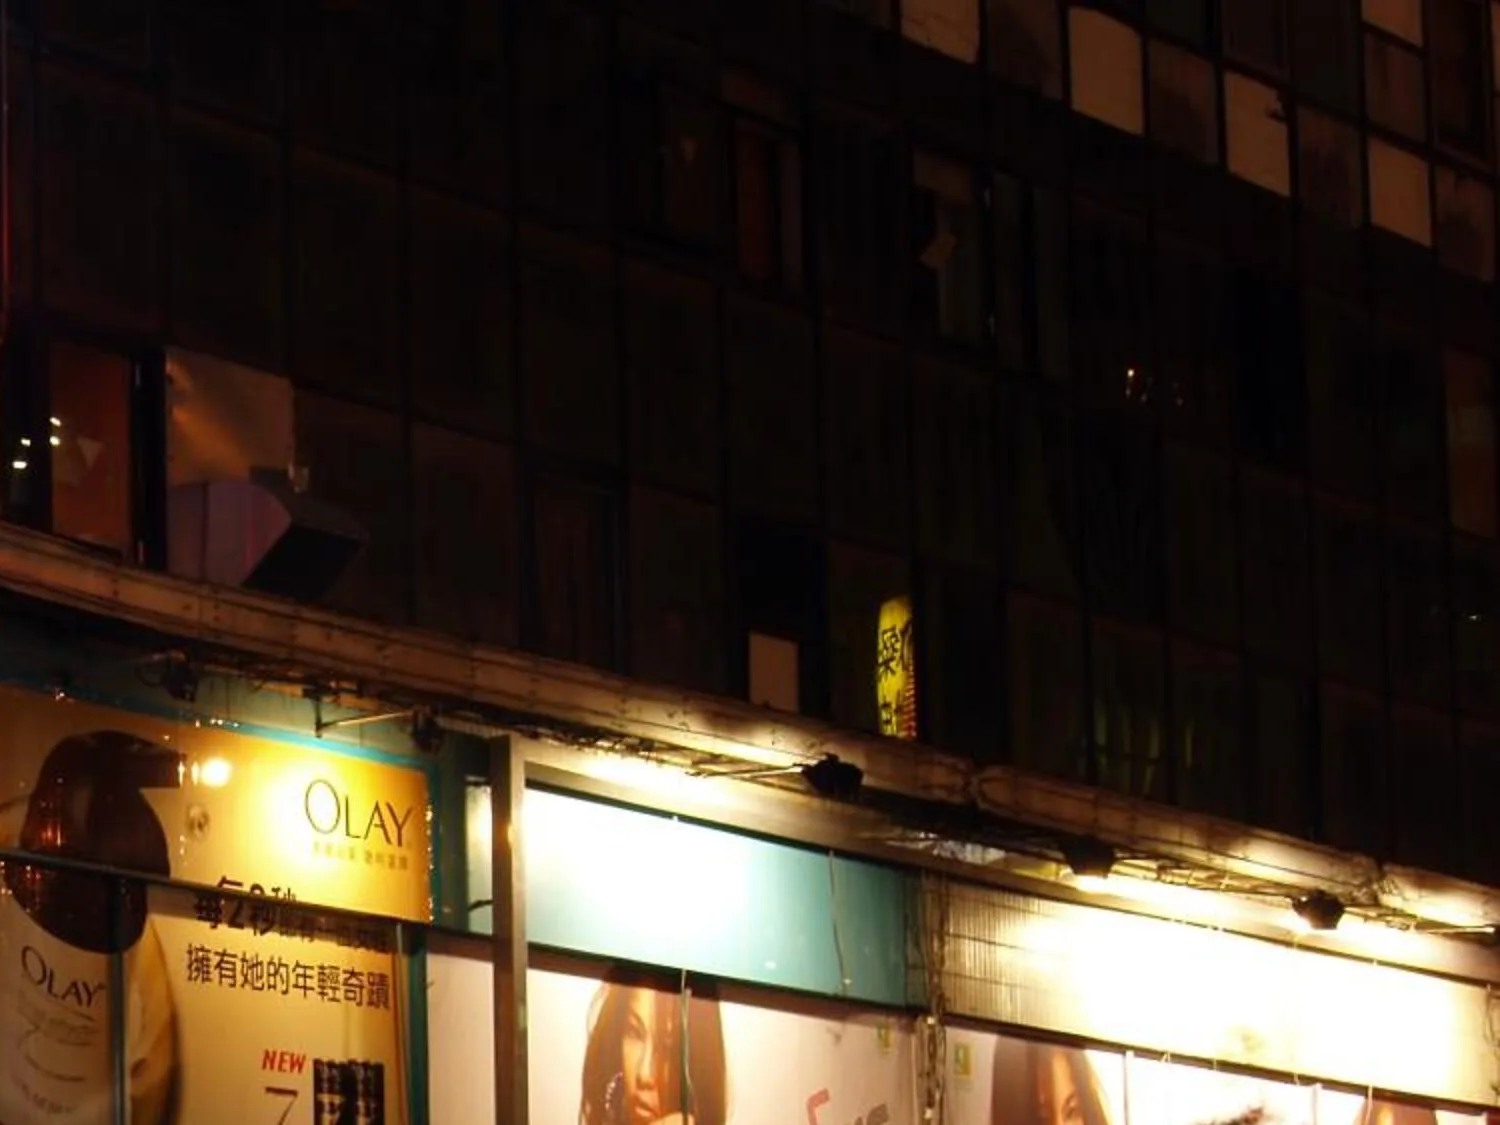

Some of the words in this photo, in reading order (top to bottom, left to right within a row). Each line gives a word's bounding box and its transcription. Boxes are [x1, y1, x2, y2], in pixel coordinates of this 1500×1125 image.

[305, 779, 414, 848] OLAY
[21, 945, 107, 1008] OLAY
[187, 943, 390, 1009] 擁有她的年輕奇蹟
[261, 1049, 307, 1075] NEW
